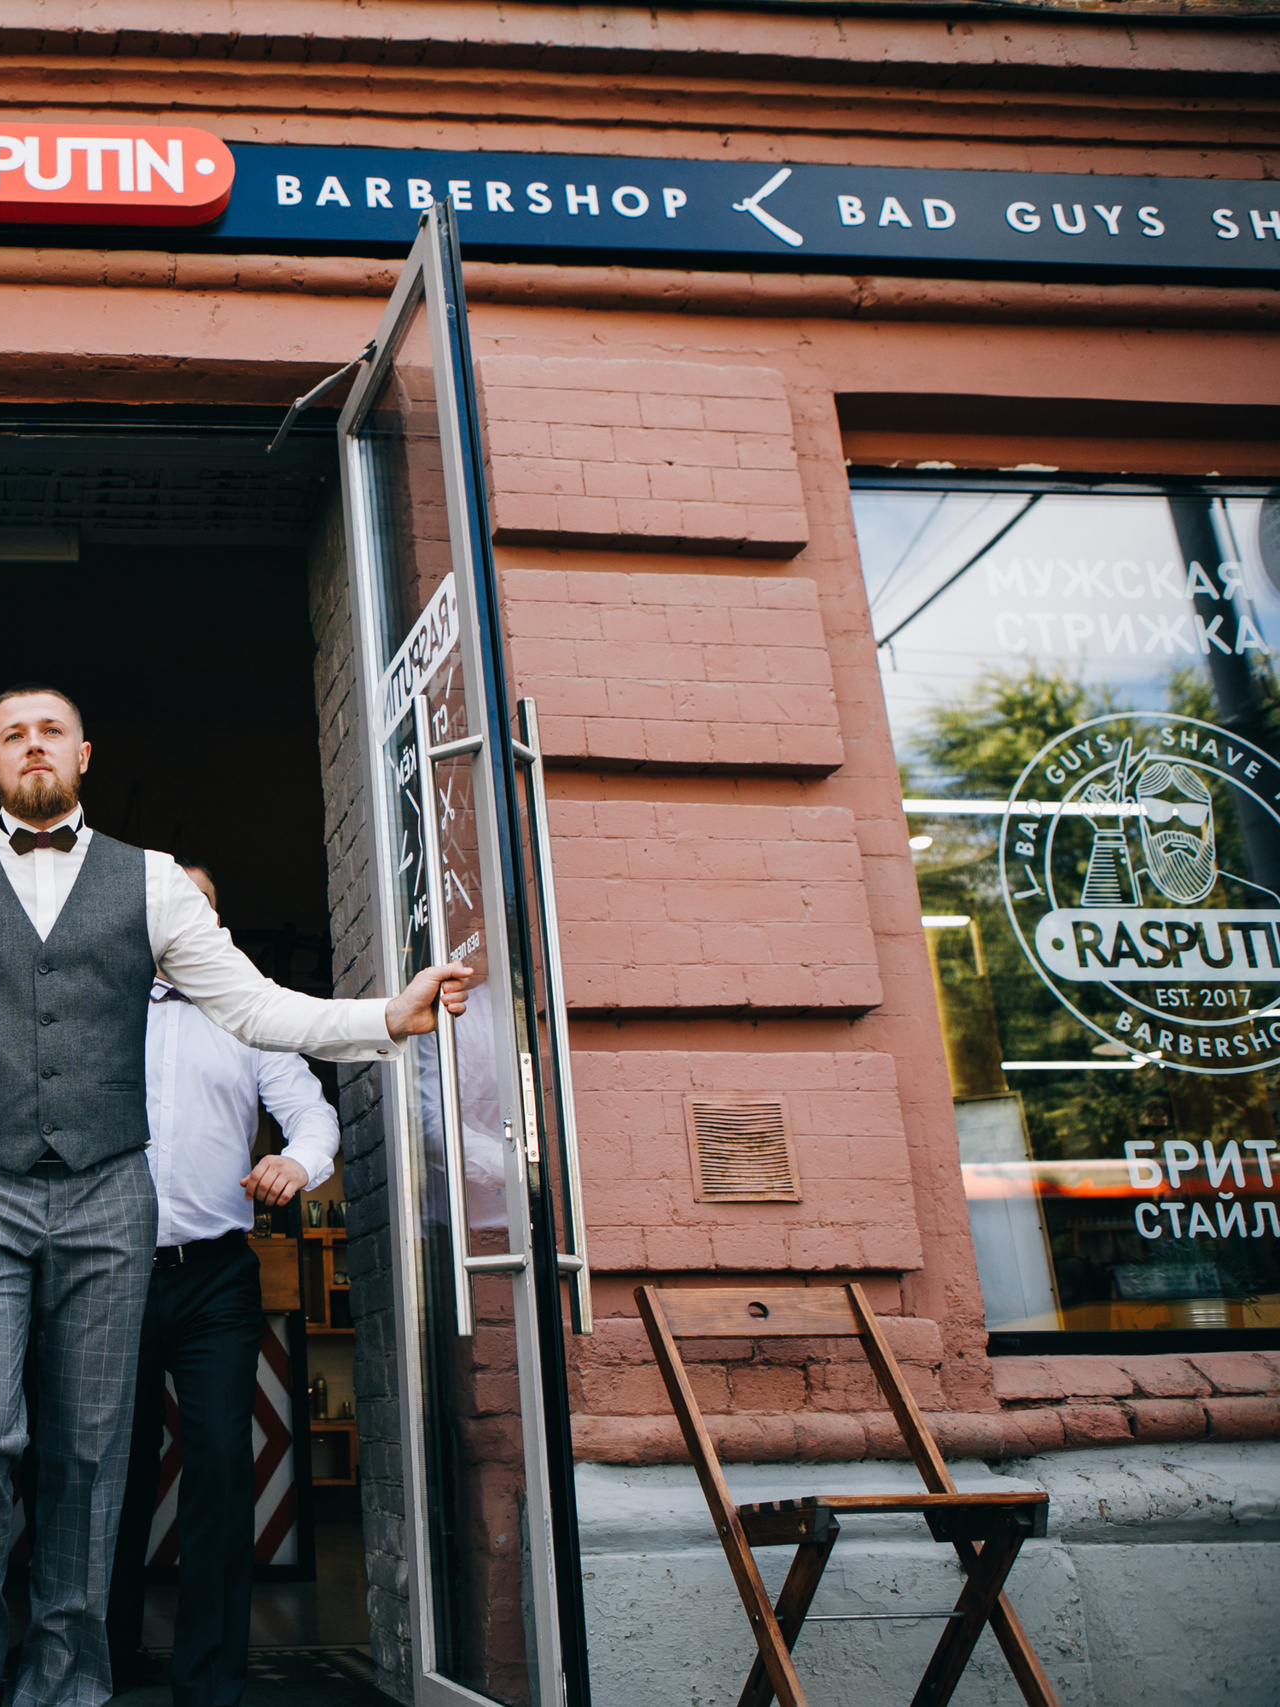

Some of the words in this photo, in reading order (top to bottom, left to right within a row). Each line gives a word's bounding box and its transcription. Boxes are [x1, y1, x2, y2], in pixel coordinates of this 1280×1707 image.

[276, 174, 688, 219] BARBERSHOP
[837, 195, 957, 230] BAD
[1005, 201, 1166, 238] GUYS
[983, 558, 1254, 601] МУЖСКАЯ
[995, 611, 1271, 656] СТРИЖКА
[1015, 799, 1043, 857] BAD
[1045, 734, 1114, 784] GUYS
[1161, 727, 1262, 780] SHAVE
[1072, 920, 1280, 969] RASPUTI
[1155, 988, 1195, 1007] EST.
[1199, 988, 1251, 1007] 2017
[1124, 1139, 1277, 1189] БРИТ
[1134, 1191, 1280, 1239] СТАЙЛ
